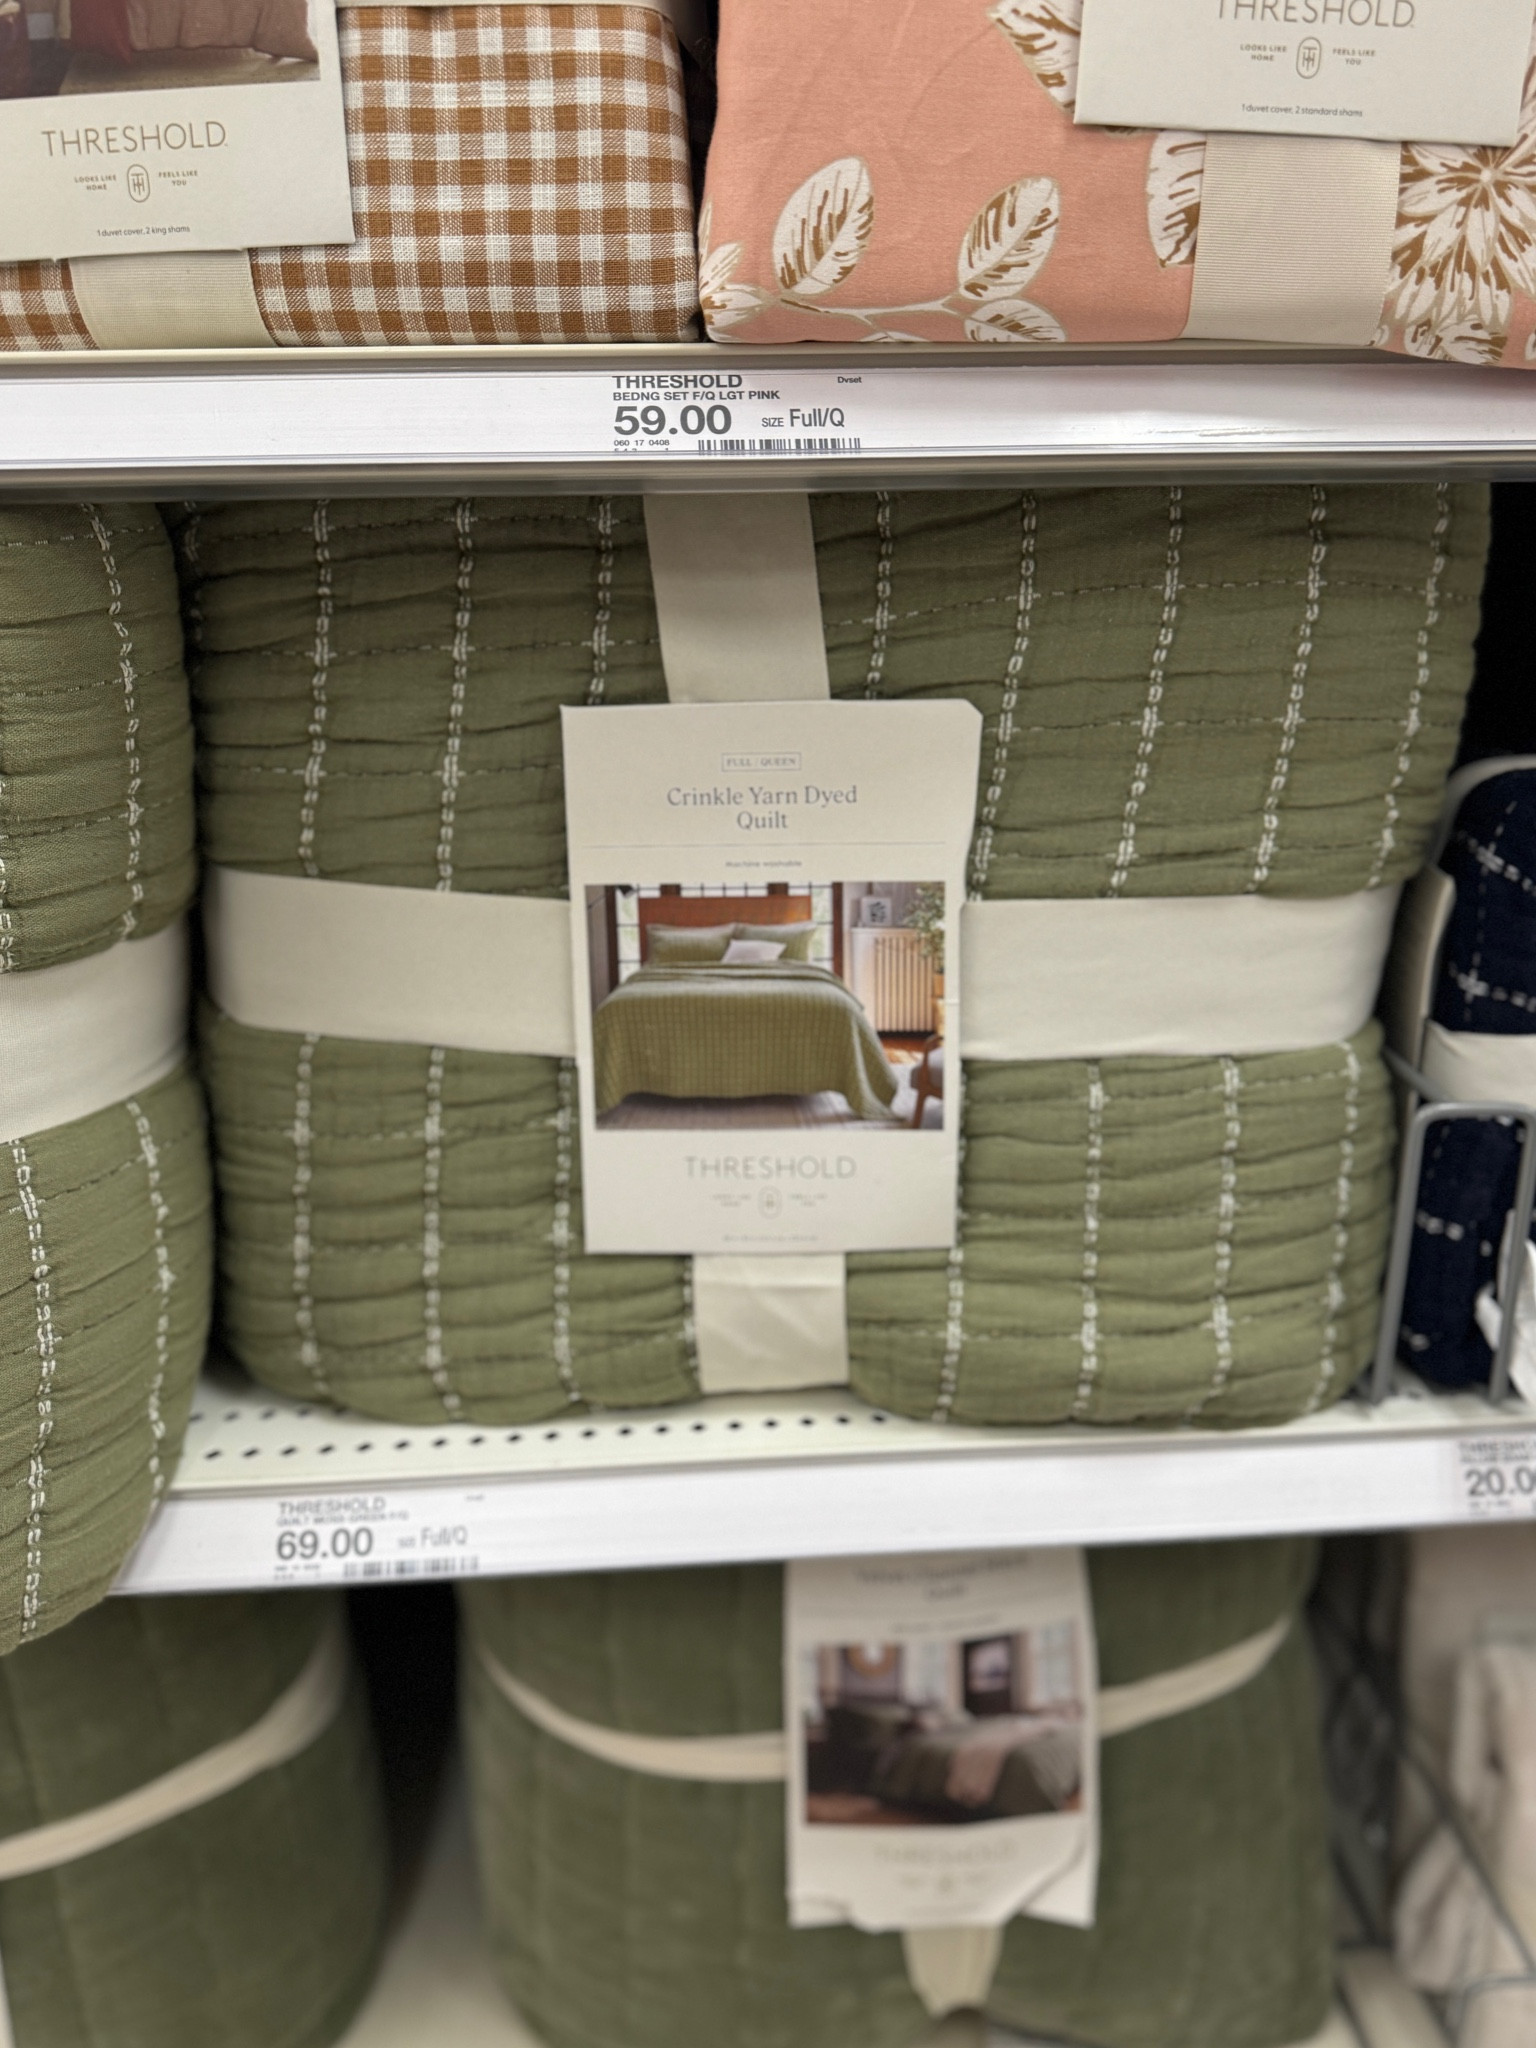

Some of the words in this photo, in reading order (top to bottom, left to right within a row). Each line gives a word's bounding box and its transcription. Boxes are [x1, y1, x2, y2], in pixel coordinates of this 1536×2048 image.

[1218, 0, 1415, 28] THRESHOLD
[1332, 48, 1356, 56] FEELS
[1358, 49, 1376, 57] LIKE
[1246, 104, 1269, 113] duvet
[1295, 105, 1300, 114] 2
[1301, 106, 1338, 116] standard
[1339, 108, 1363, 117] shams
[41, 121, 227, 157] THRESHOLD
[74, 175, 99, 183] LOOKS
[101, 174, 117, 182] LIKE
[86, 183, 107, 191] HOME
[101, 229, 122, 237] duvet
[151, 226, 167, 235] king
[168, 225, 191, 233] shams
[612, 375, 742, 389] THRESHOLD
[837, 376, 862, 384] Dvset
[613, 392, 660, 401] BEDNG
[664, 392, 689, 401] SET
[693, 391, 715, 401] F/Q
[719, 391, 745, 400] LGT
[748, 390, 780, 400] PINK
[613, 404, 732, 436] 59.00
[761, 417, 784, 427] SIZE
[789, 407, 845, 427] Full/Q
[613, 439, 630, 447] 060
[726, 757, 751, 767] FULL
[760, 756, 796, 767] QUEEN
[666, 787, 744, 806] Crinkle
[749, 786, 798, 805] Yarn
[804, 785, 858, 808] Dyed
[736, 811, 789, 830] Quilt
[684, 1154, 858, 1181] THRESHOLD
[279, 1497, 386, 1515] THRESHOLD
[276, 1526, 374, 1560] 69.00
